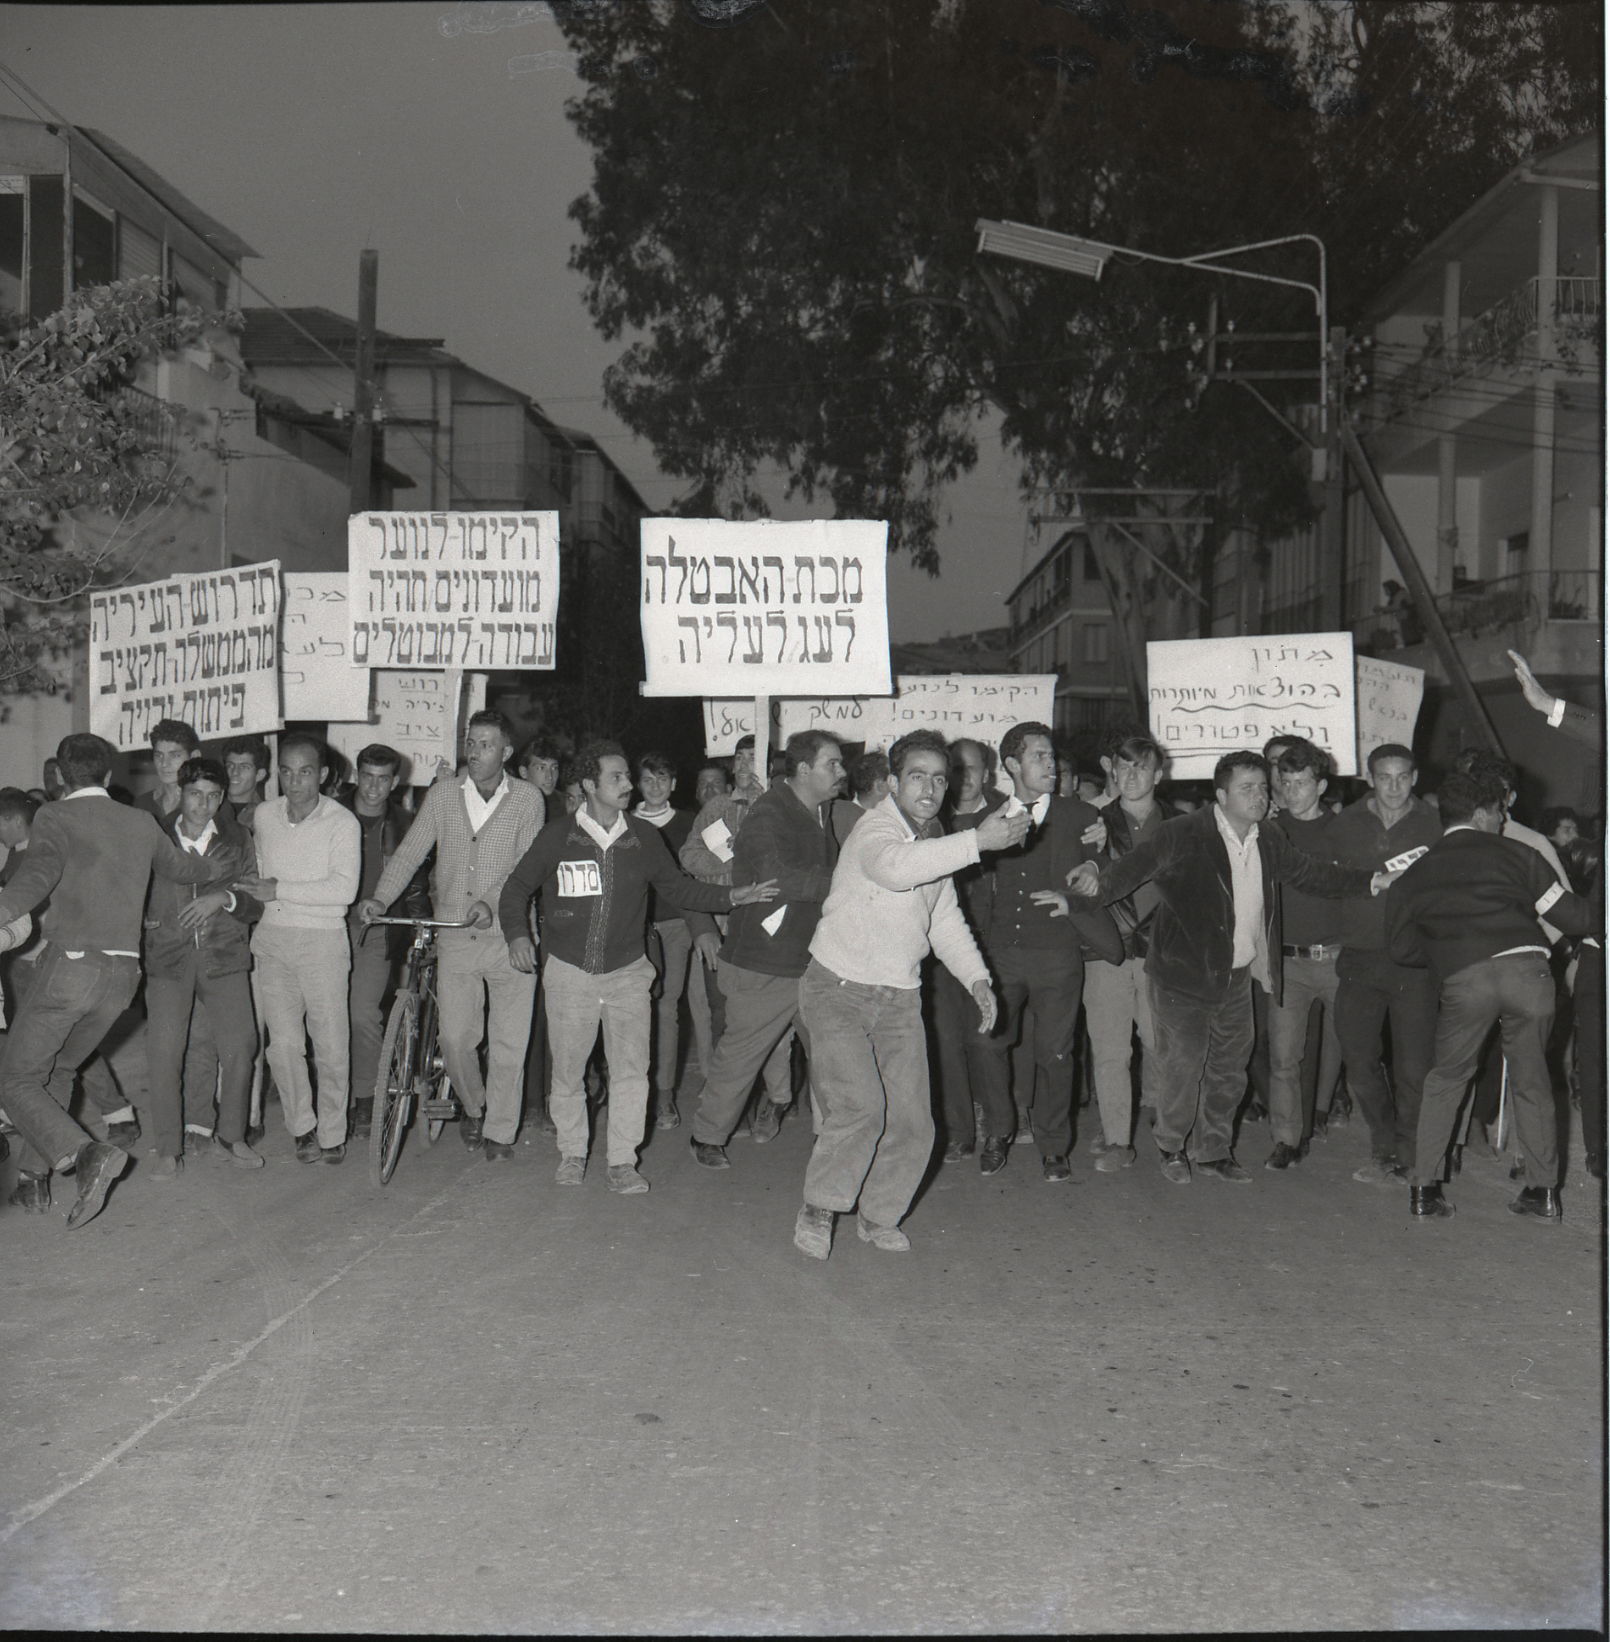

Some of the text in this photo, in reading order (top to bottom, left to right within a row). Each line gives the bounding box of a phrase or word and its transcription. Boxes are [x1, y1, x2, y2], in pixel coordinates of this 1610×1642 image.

[435, 570, 541, 612] מועדונים
[901, 680, 1038, 702] הקימו לנוע
[1150, 686, 1217, 704] מיותרות
[1228, 676, 1341, 699] בהוצאות
[1271, 719, 1329, 742] ולא
[560, 863, 599, 894] סדרן
